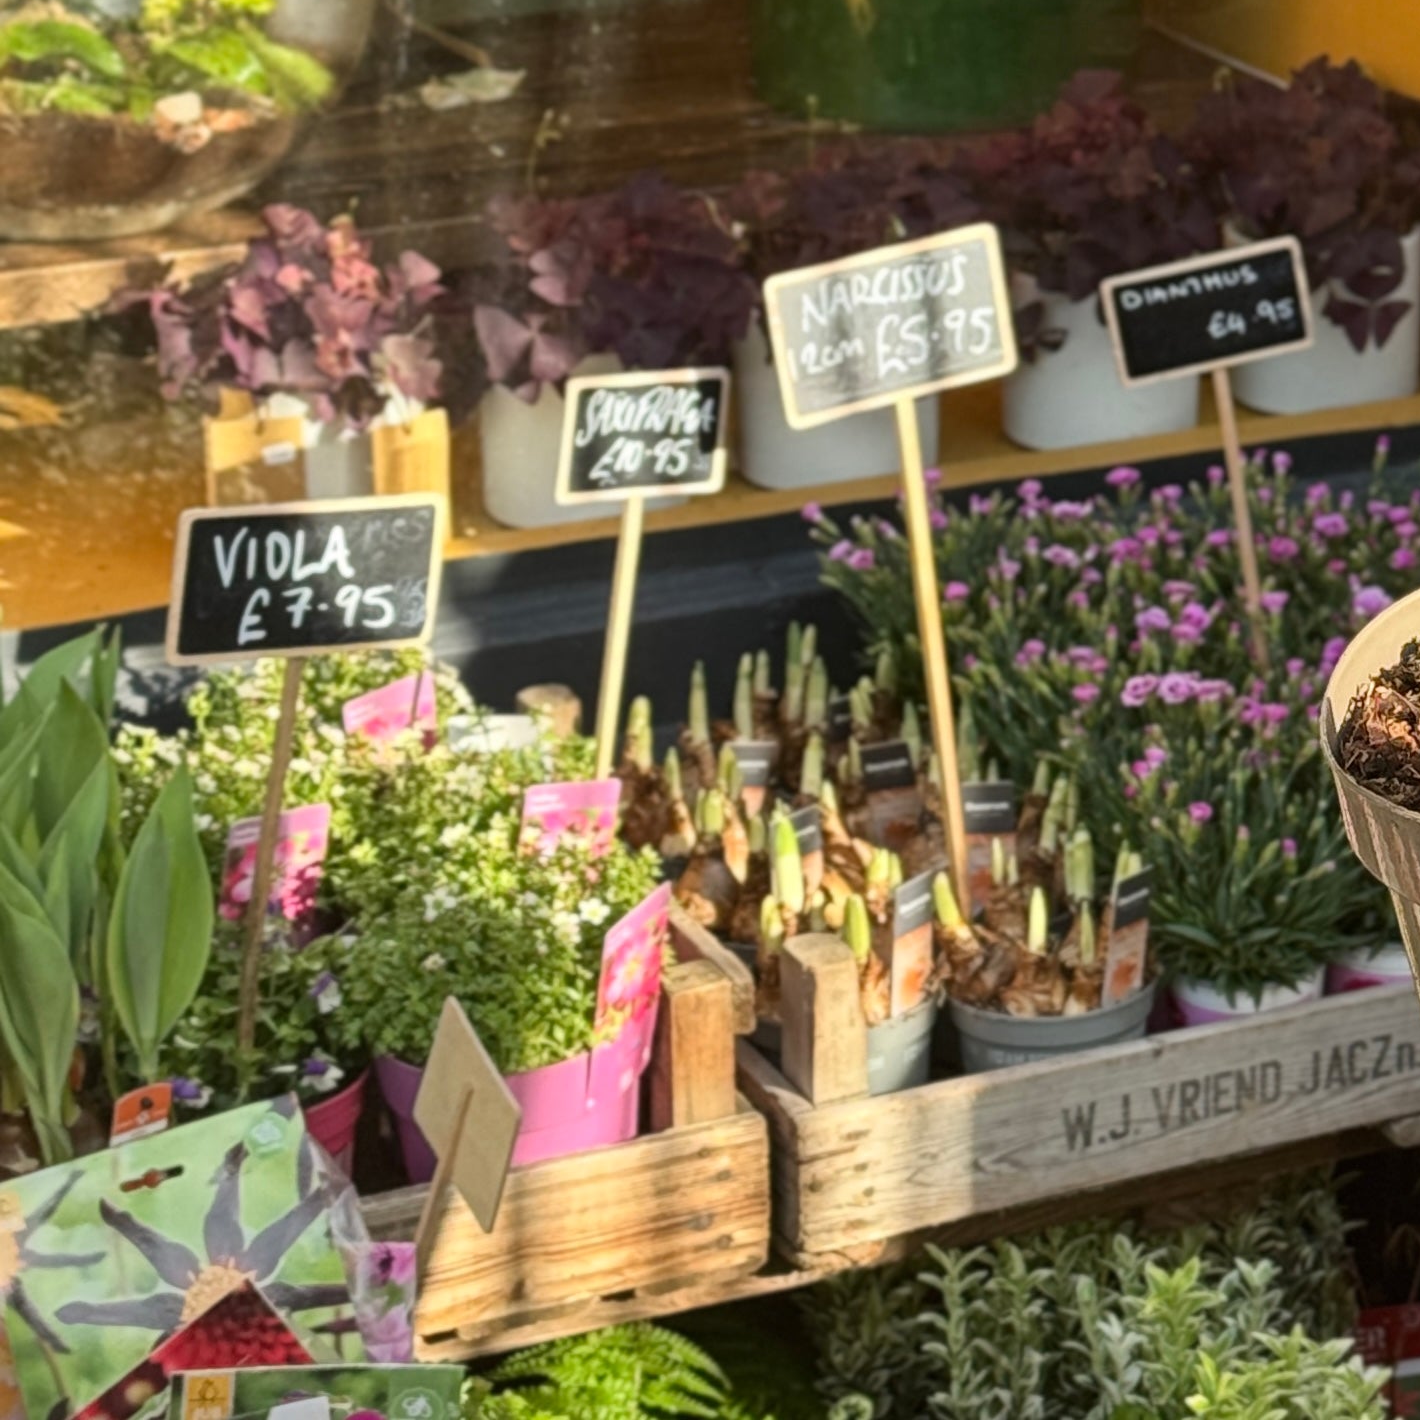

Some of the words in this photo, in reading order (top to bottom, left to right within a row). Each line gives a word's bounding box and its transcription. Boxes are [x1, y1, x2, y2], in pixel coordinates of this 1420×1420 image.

[801, 252, 968, 333] NARCISSUS
[1119, 264, 1258, 311] DIANTHUS
[213, 524, 356, 589] VIOLA
[1151, 1059, 1283, 1130] VRIEND
